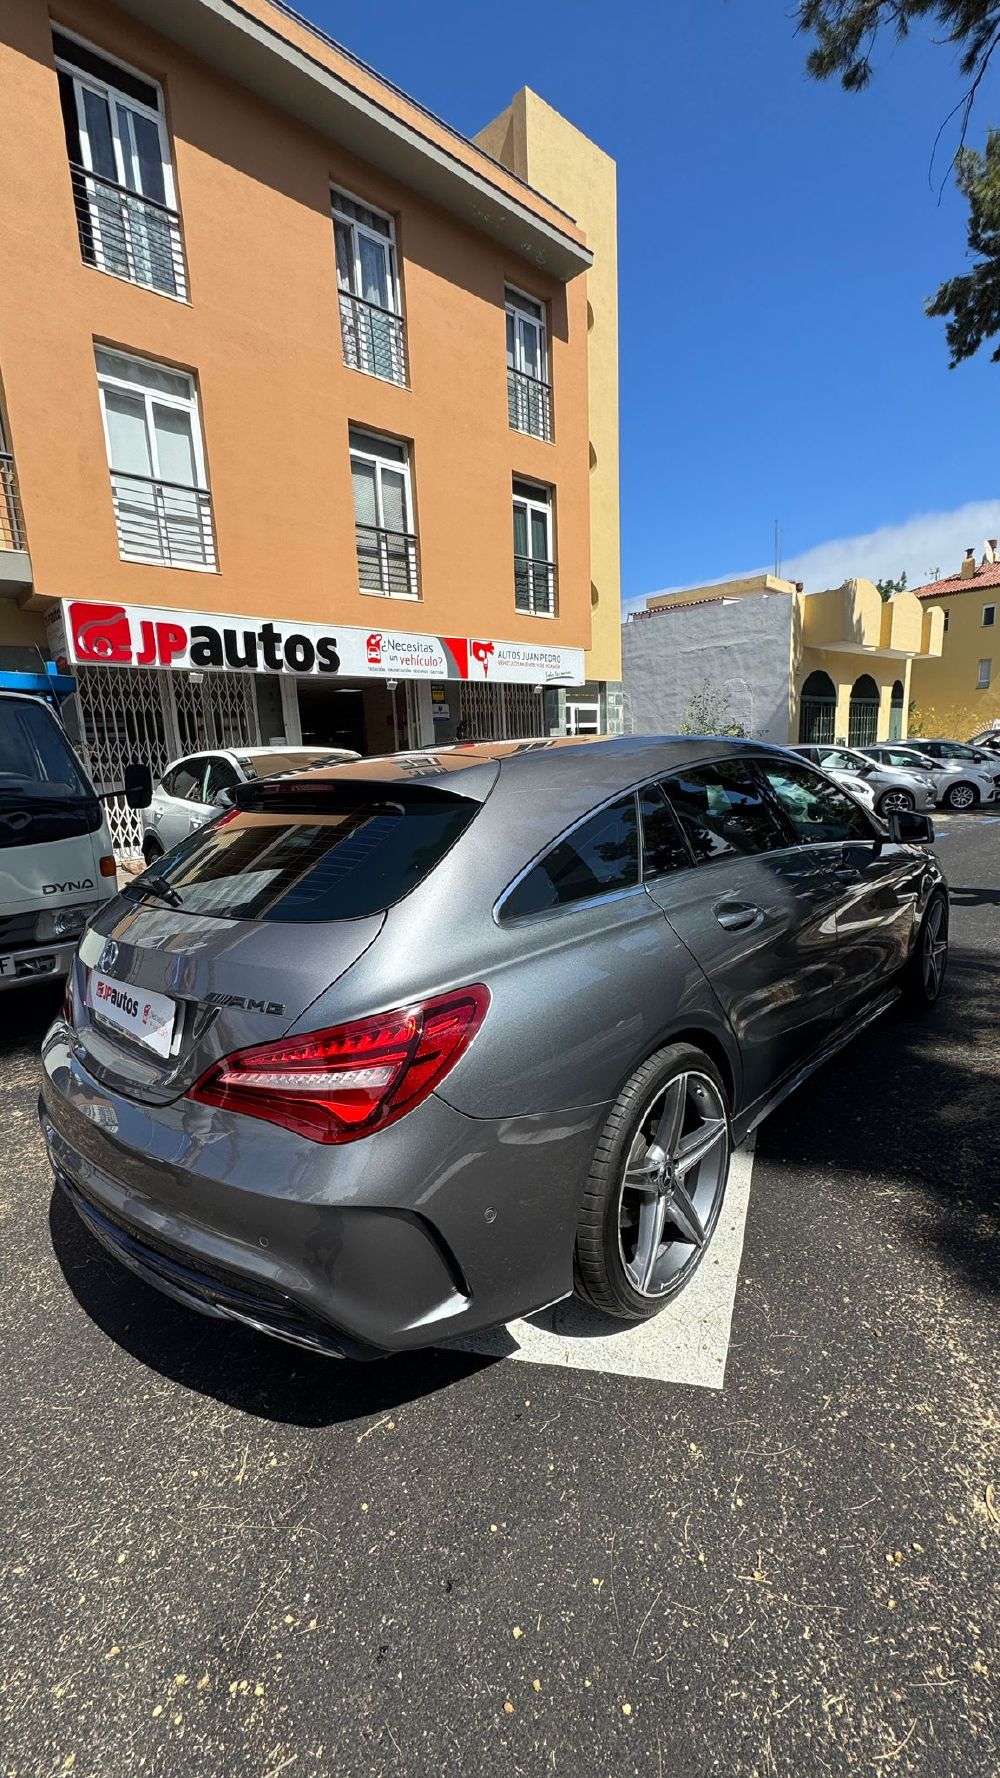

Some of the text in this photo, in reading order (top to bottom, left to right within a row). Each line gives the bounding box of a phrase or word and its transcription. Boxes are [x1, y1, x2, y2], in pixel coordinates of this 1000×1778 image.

[381, 638, 434, 653] ¿Necesitas
[400, 654, 443, 667] vehículo?
[497, 650, 521, 660] AUTOS
[42, 879, 94, 895] DYNA
